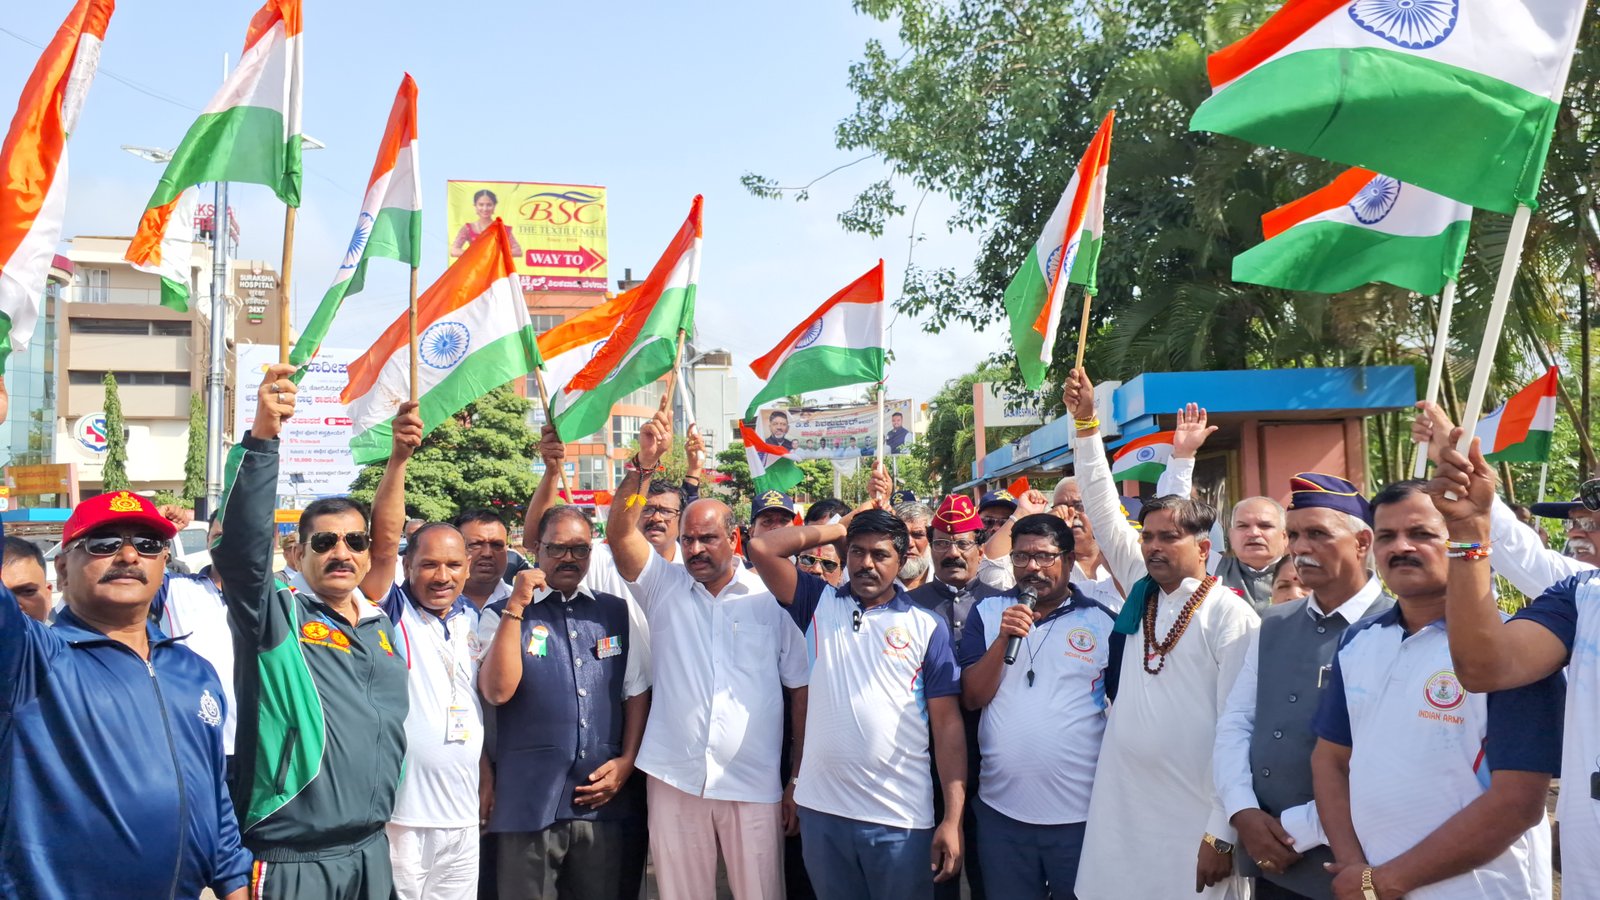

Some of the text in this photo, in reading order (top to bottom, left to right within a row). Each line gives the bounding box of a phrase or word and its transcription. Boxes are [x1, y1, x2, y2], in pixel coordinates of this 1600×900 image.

[519, 200, 604, 225] BSC
[519, 225, 605, 237] THE TEXTILE MALL
[530, 253, 583, 265] WAY TO
[240, 274, 275, 282] SURAKSHA
[239, 281, 274, 289] HOSPITAL
[1418, 710, 1465, 725] INDIAN ARMY
